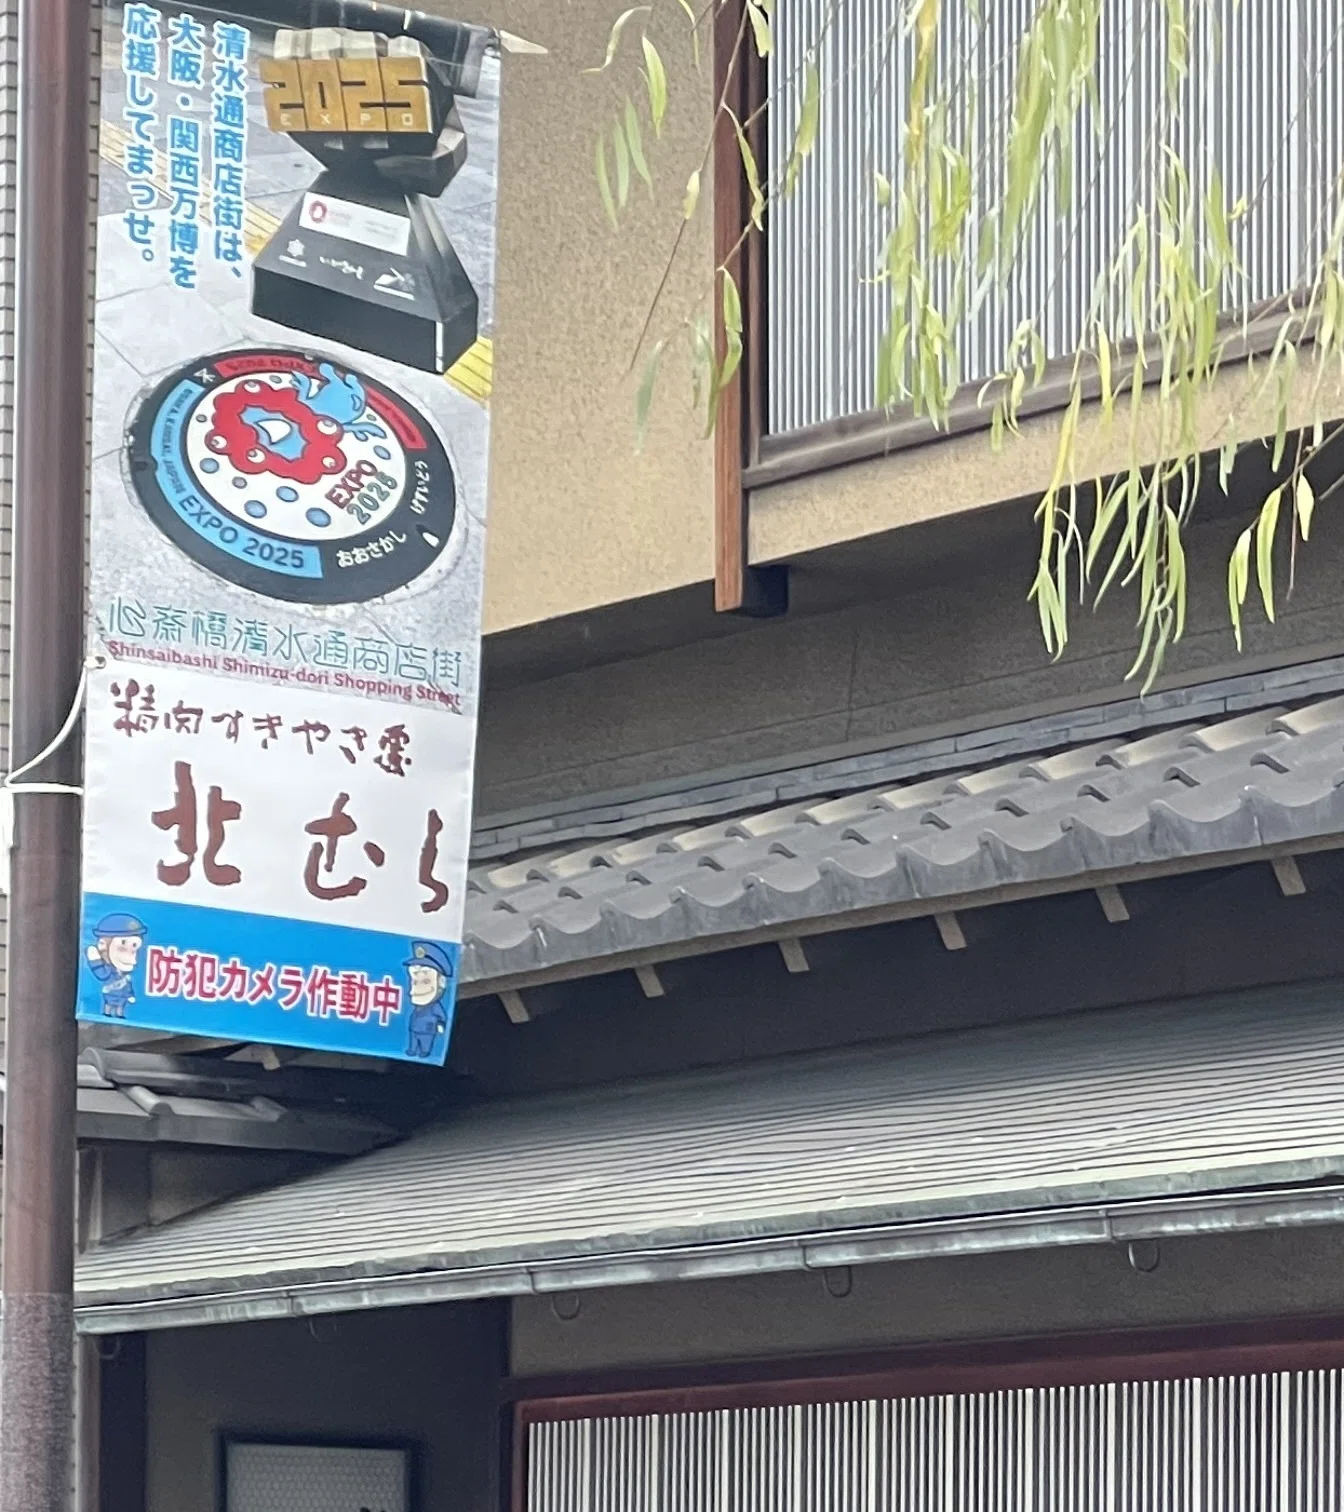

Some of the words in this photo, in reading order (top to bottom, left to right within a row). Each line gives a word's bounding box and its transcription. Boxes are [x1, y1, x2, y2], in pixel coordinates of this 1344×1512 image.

[123, 4, 161, 263] 応援してまっせ。
[168, 16, 204, 290] 大阪・関西万博を
[213, 22, 249, 279] 清水通商店街は、
[325, 459, 378, 510] EXPO
[346, 470, 398, 526] 2025
[179, 494, 239, 545] EXPO
[241, 536, 305, 570] 2025
[336, 530, 407, 568] おおさかし
[108, 639, 219, 670] Shinsaibashi
[222, 656, 329, 686] Shimizu-dori
[333, 672, 412, 701] Shopping
[415, 683, 462, 707] Street
[151, 760, 450, 914] 北むら
[145, 947, 403, 1027] 防犯カメラ作動中
